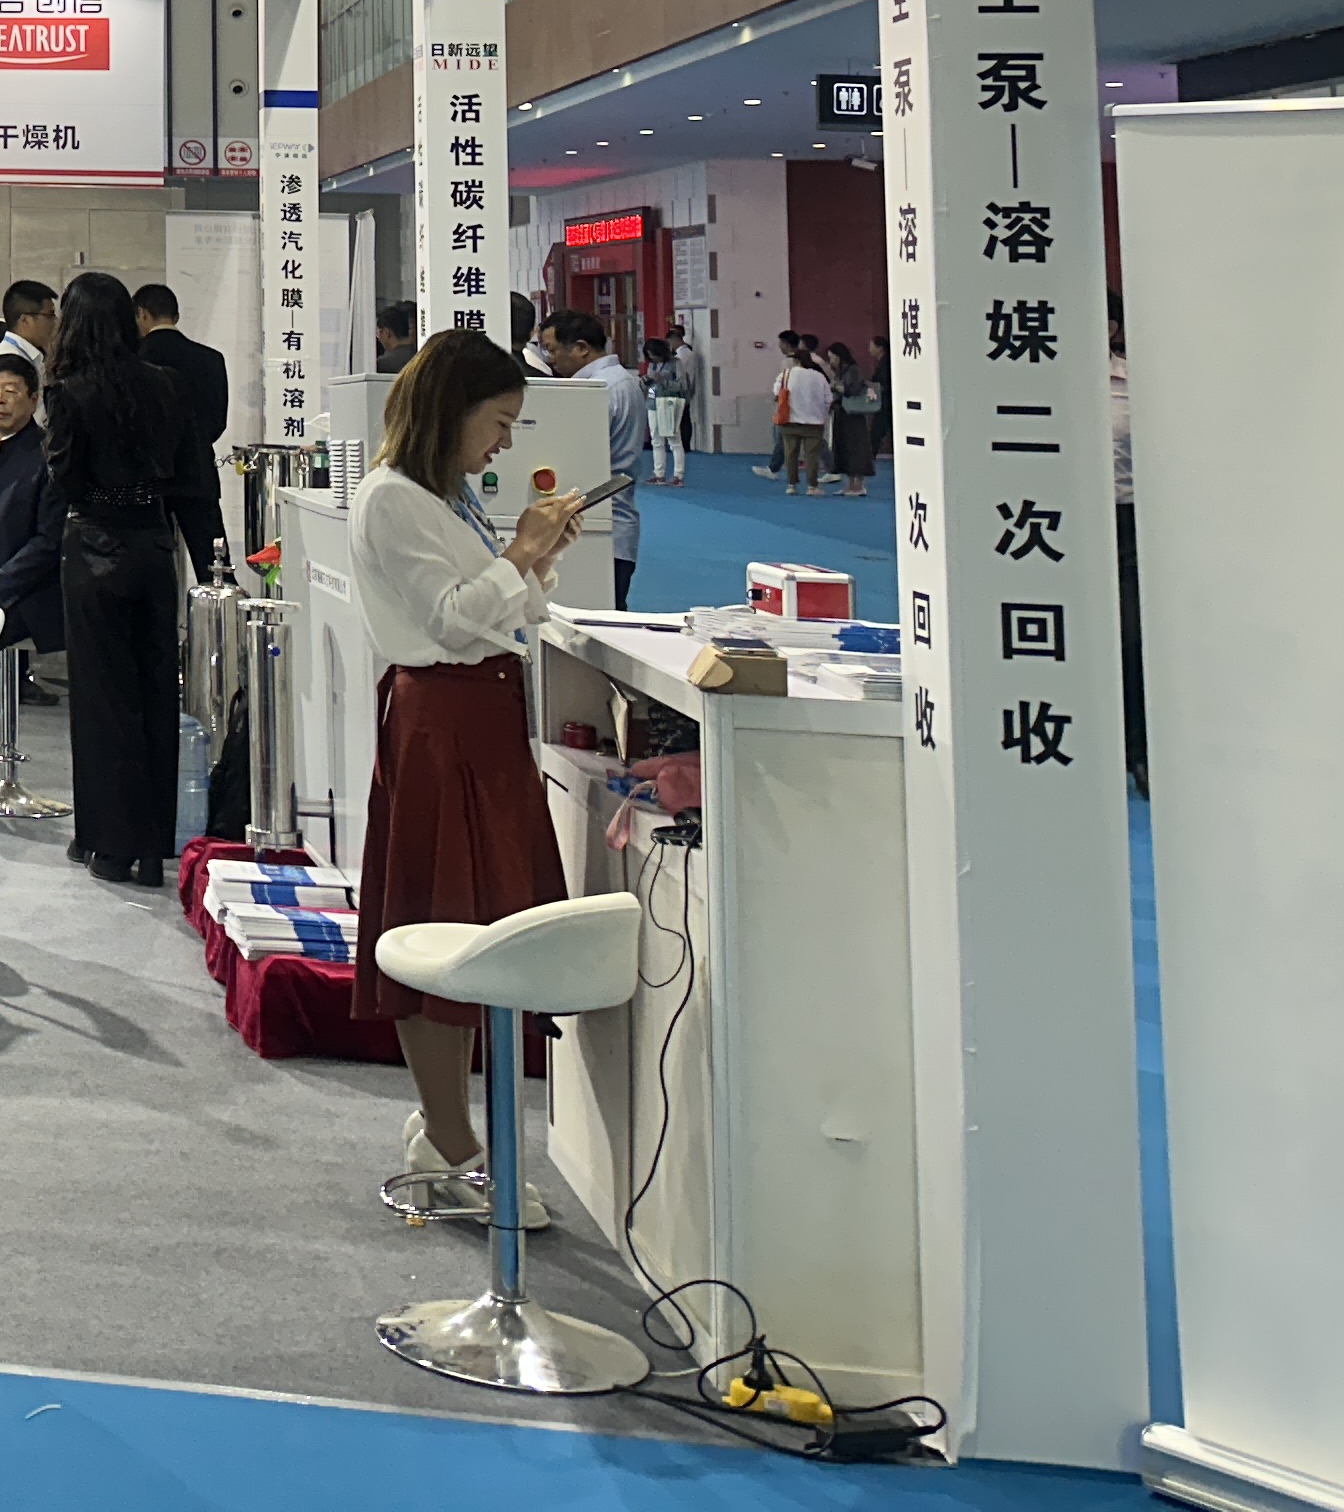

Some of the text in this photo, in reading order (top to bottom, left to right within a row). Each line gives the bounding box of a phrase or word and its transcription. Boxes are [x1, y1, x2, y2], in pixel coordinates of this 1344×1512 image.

[432, 59, 500, 71] MIDE
[450, 92, 487, 335] 活性碳纤维膜
